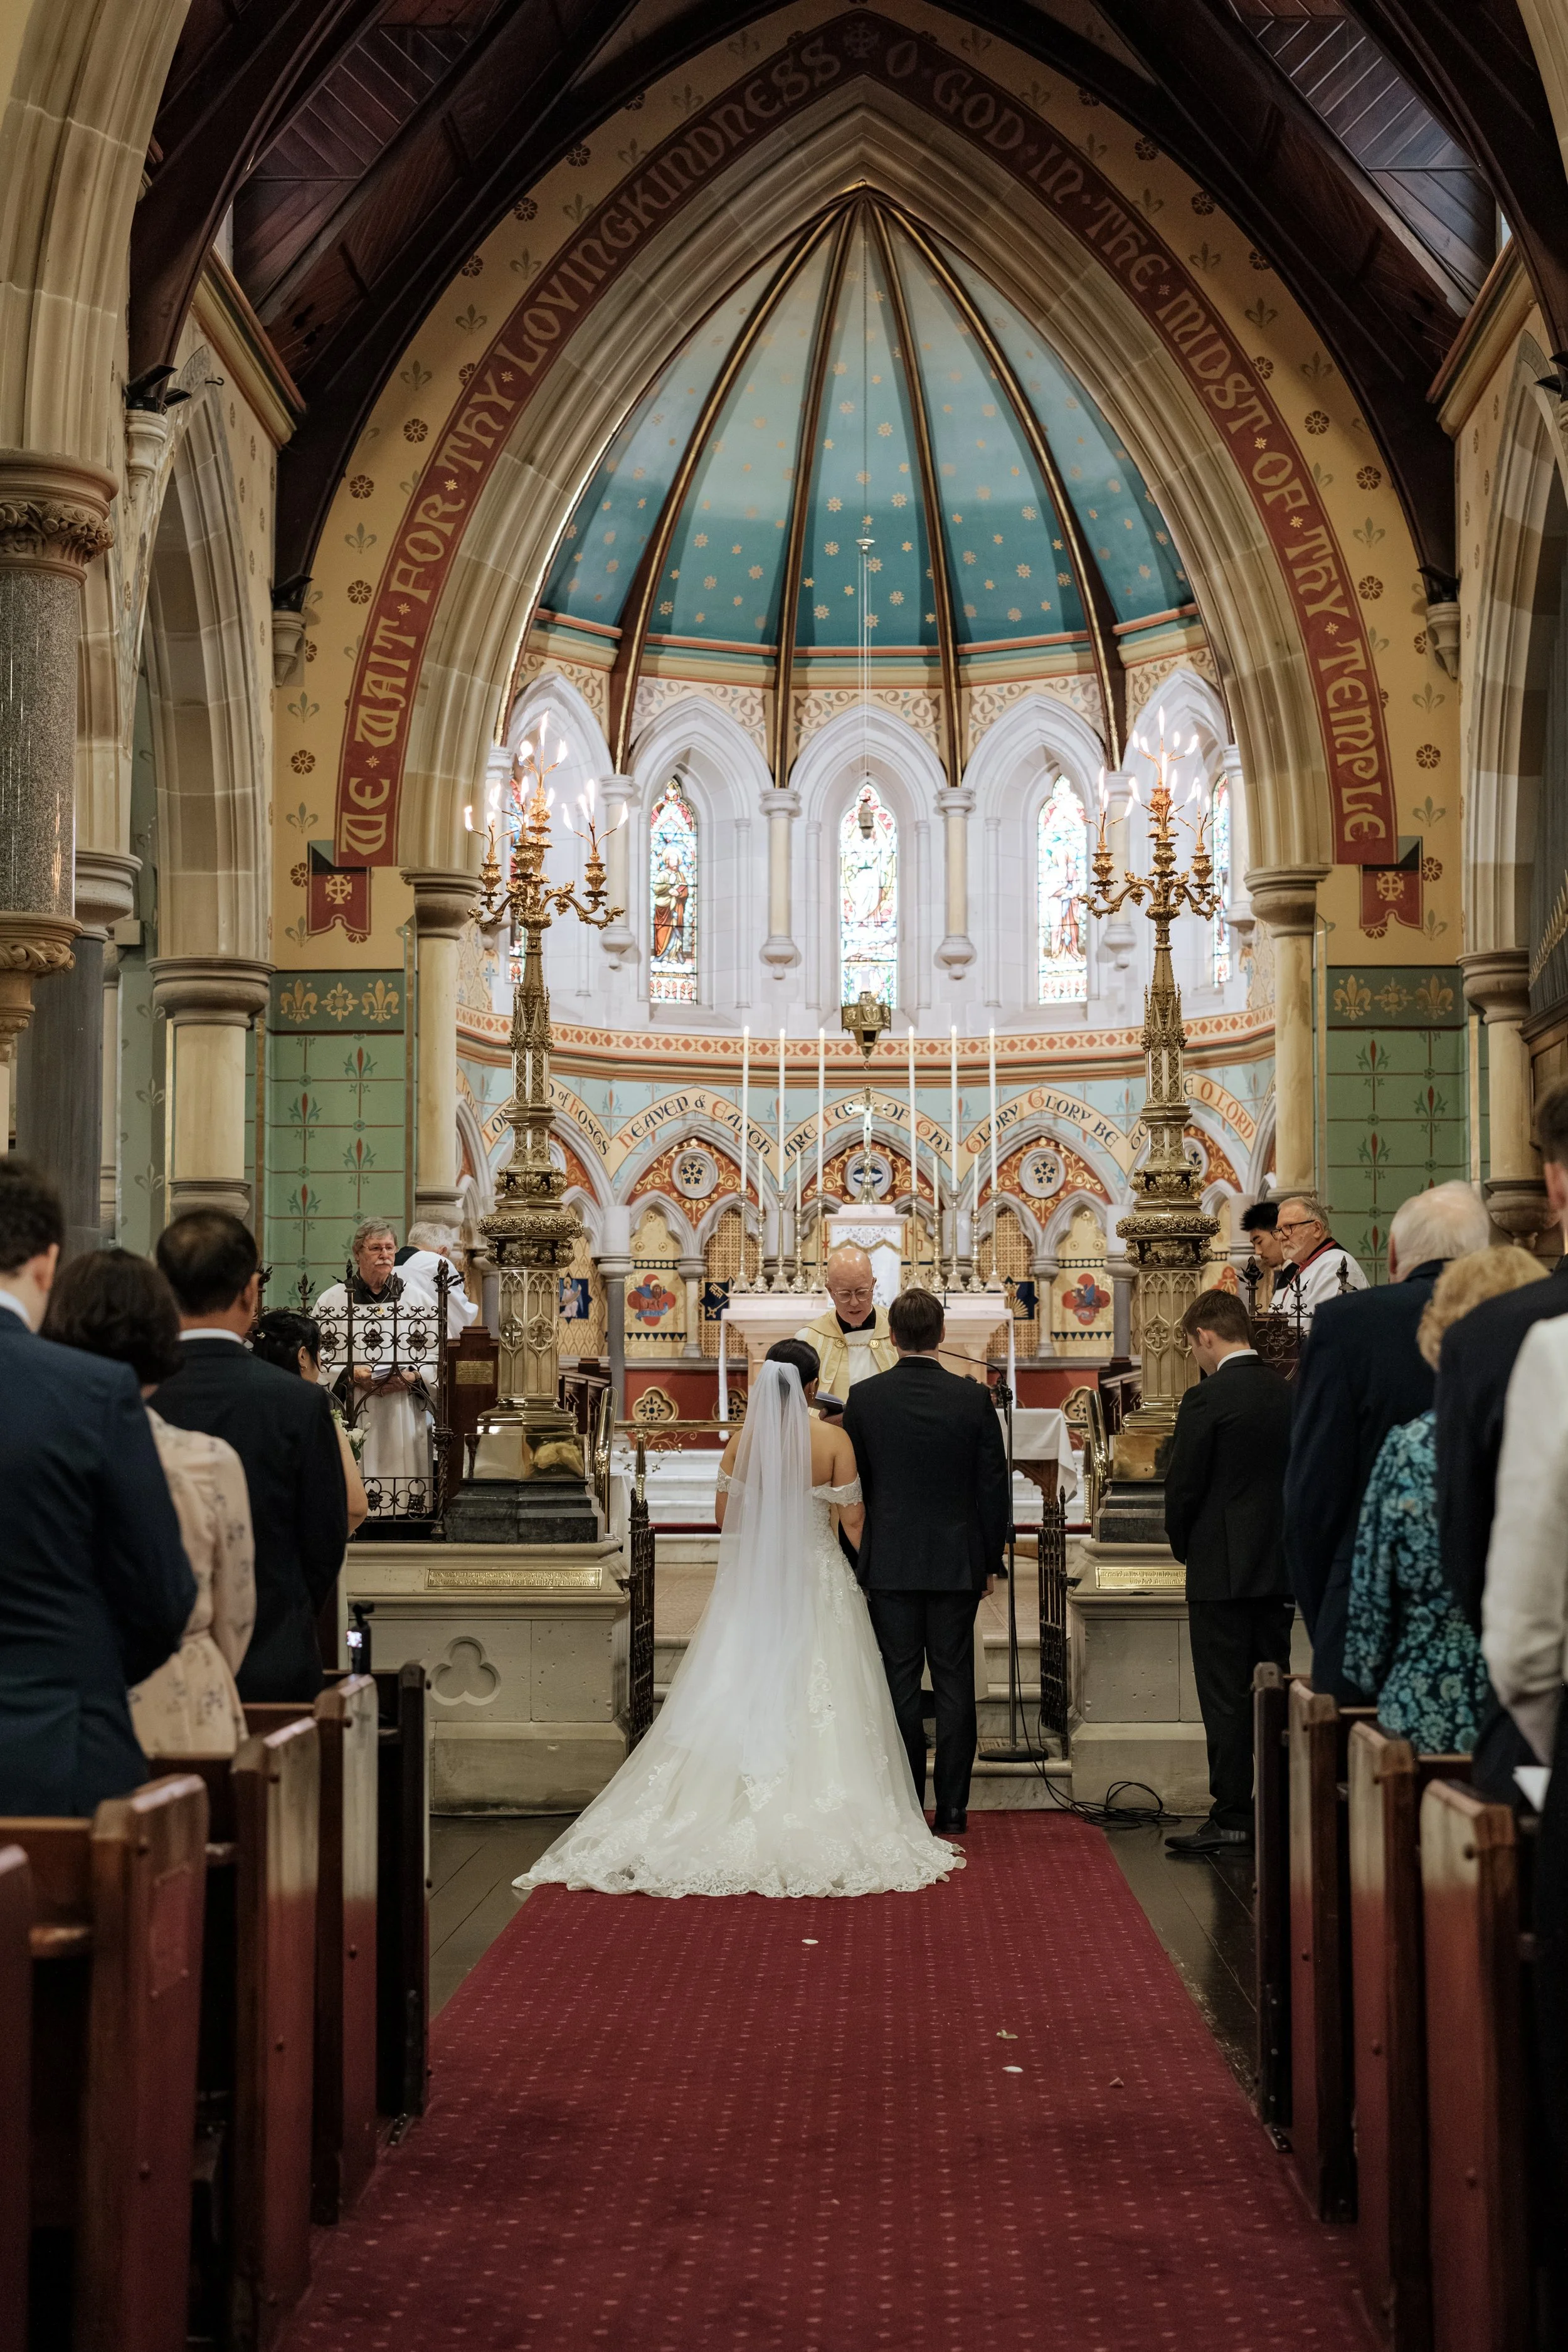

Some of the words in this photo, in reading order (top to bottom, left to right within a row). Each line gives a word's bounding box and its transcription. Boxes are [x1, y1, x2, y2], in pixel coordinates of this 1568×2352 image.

[446, 373, 517, 473] THY
[887, 41, 918, 79] O
[933, 67, 1025, 151] GOD
[1026, 143, 1085, 205] IN
[1086, 196, 1170, 294] THE
[1157, 291, 1271, 434] MIDST
[1251, 452, 1311, 513] OF
[1285, 524, 1350, 620] THY
[1320, 638, 1387, 843] TEMPLE
[389, 494, 467, 603] FOR
[354, 617, 416, 748] WAIT
[341, 778, 389, 856] WE
[784, 1123, 818, 1160] ARE
[966, 1103, 1018, 1153] GLORY
[1028, 1089, 1093, 1123] GLORY
[1091, 1120, 1120, 1148] BE
[1200, 1081, 1213, 1100] O
[1216, 1090, 1254, 1138] LORD
